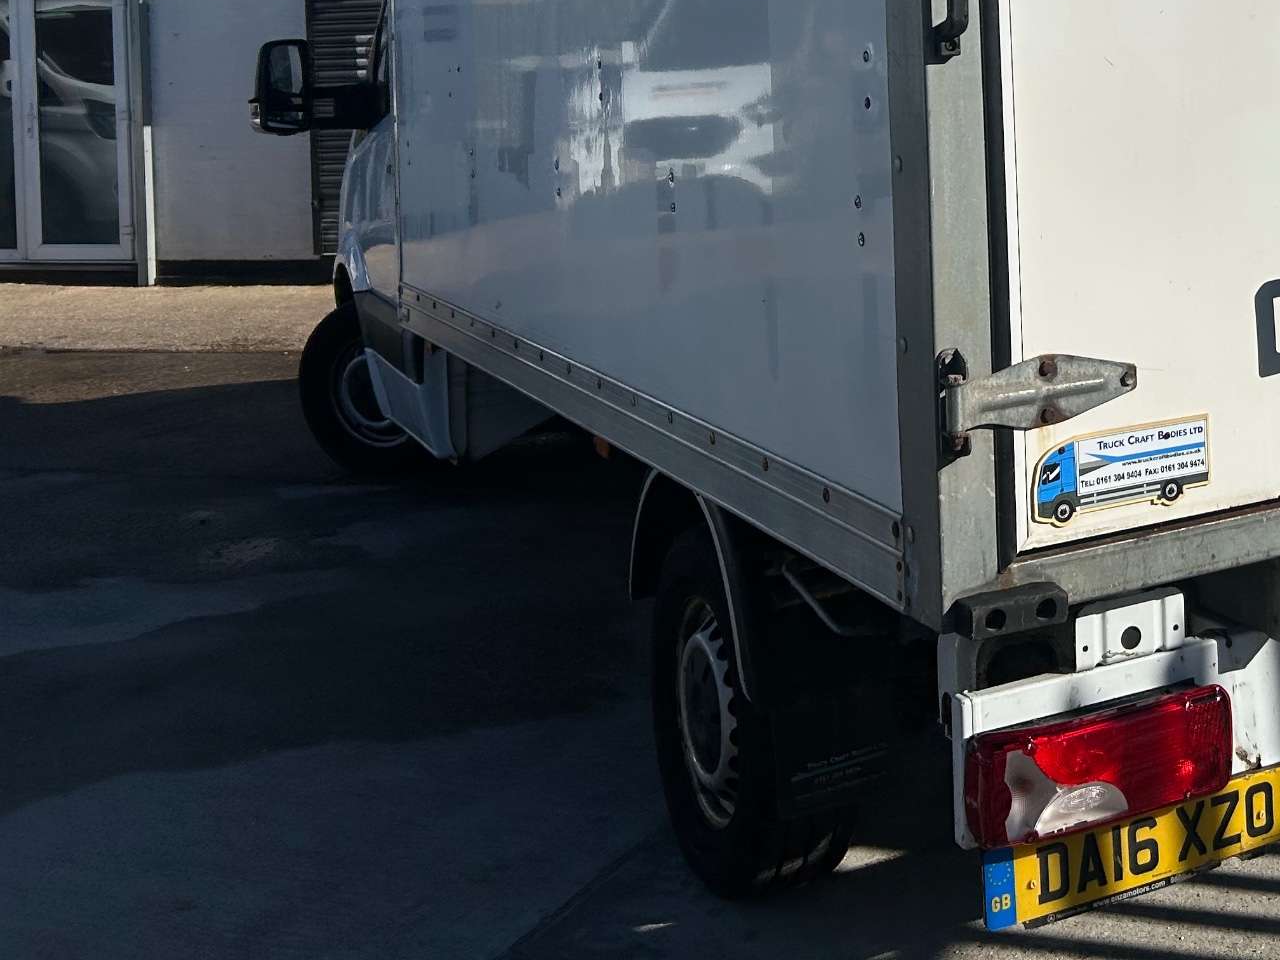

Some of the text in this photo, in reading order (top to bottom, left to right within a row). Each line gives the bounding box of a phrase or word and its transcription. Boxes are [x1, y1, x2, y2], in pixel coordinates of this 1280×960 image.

[1096, 475, 1112, 485] 0161
[1160, 463, 1175, 473] 0161
[1036, 781, 1275, 905] DA16 XZO
[991, 893, 1012, 913] GB
